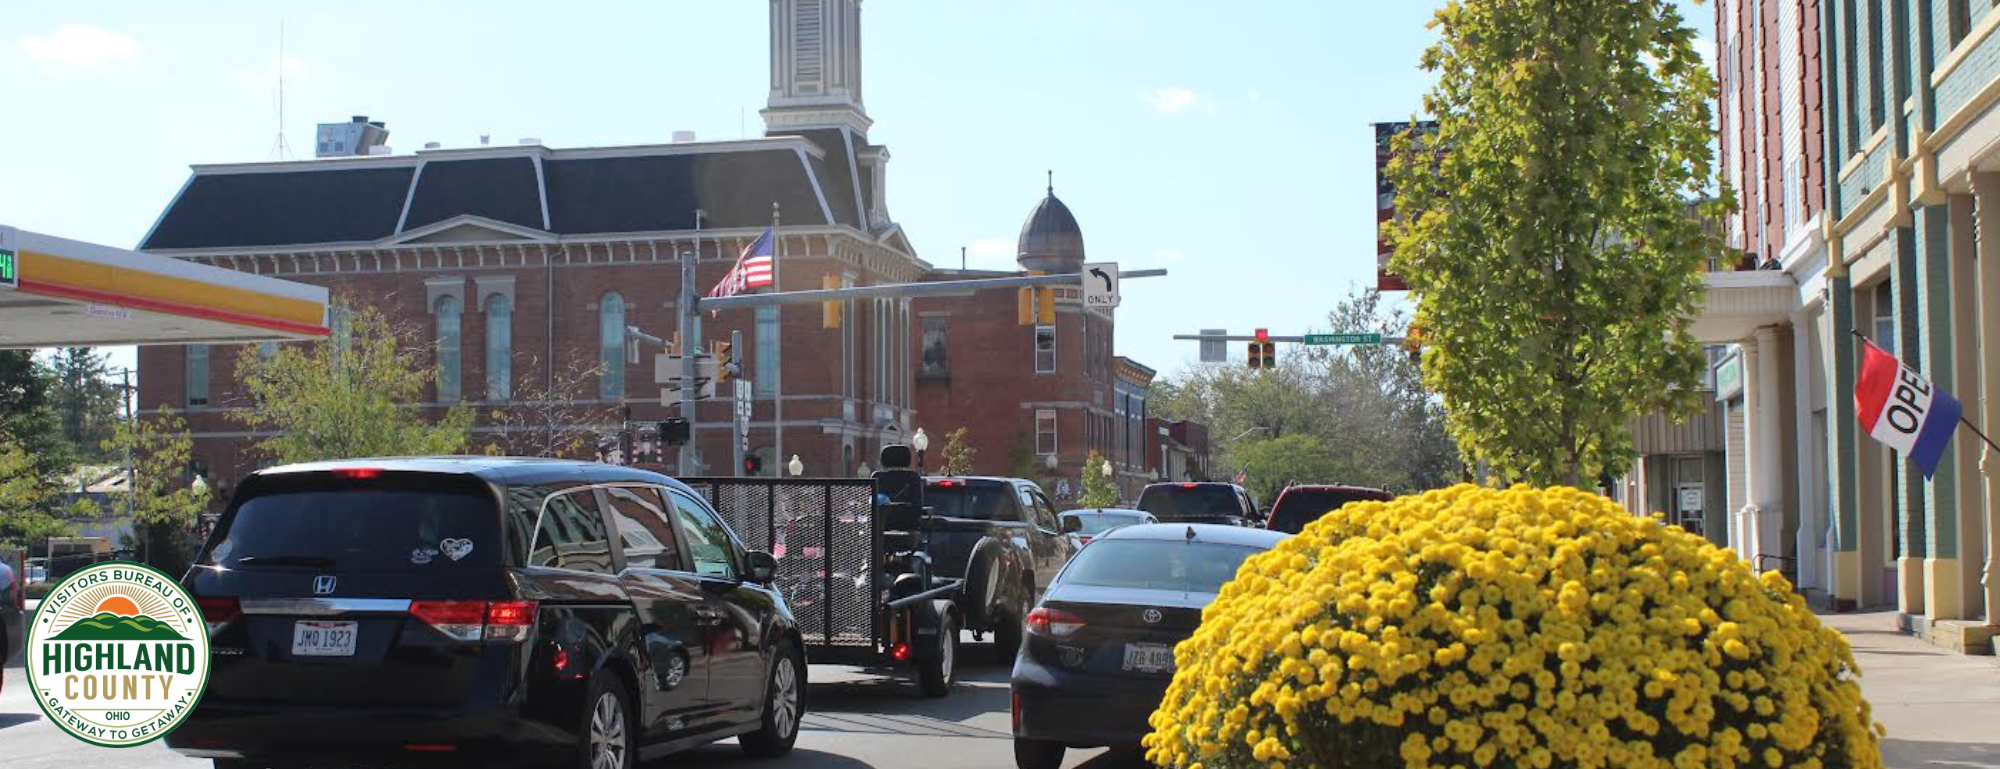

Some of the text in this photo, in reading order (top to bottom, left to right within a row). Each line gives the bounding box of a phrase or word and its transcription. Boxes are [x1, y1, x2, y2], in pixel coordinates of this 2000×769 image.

[1088, 295, 1113, 304] ONLY
[1312, 334, 1372, 343] WASHINGTON ST
[1886, 363, 1930, 434] OPE
[322, 630, 351, 648] 1923
